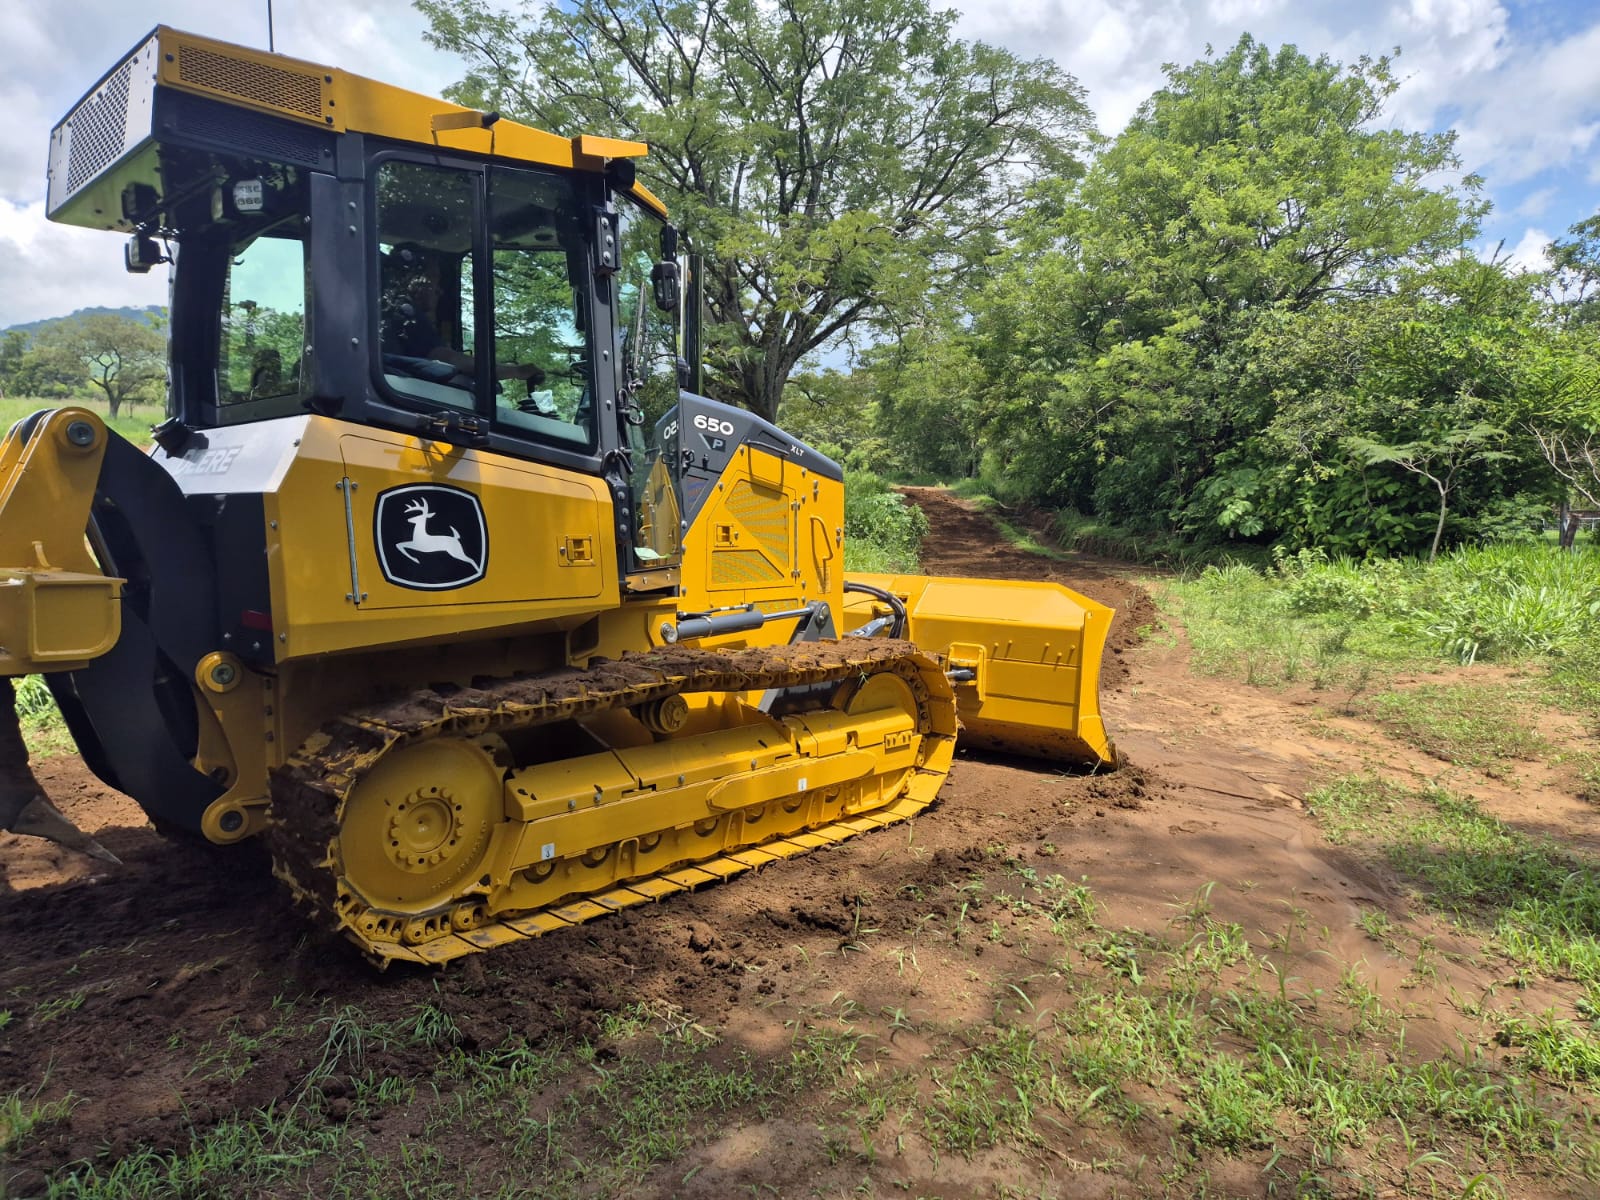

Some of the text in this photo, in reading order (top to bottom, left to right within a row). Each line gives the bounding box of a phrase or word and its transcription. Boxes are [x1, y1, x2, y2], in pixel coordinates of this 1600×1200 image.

[693, 414, 735, 436] 650
[712, 439, 724, 449] P
[790, 444, 805, 457] XLT
